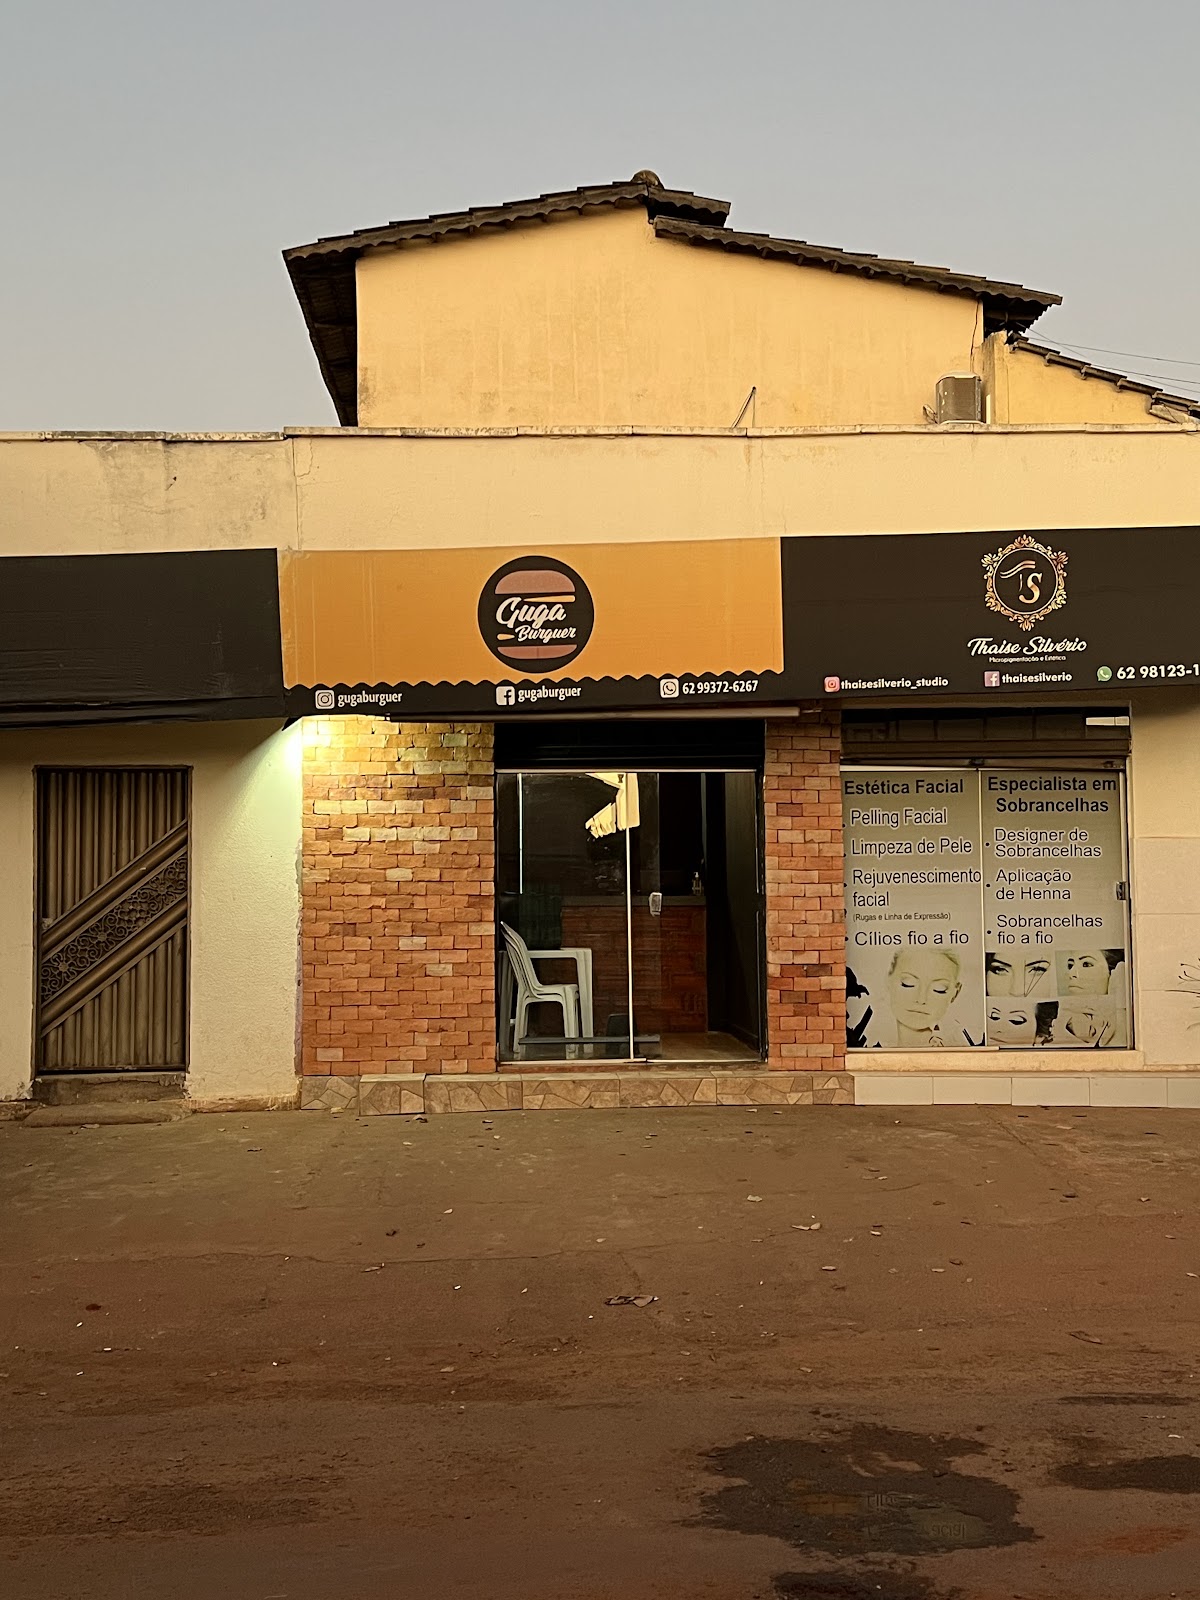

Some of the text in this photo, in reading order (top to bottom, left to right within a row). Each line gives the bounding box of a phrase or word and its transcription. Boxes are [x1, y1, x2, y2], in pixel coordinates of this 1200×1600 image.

[496, 597, 567, 629] Guga
[515, 625, 577, 644] Burguer
[967, 635, 1088, 657] Thaise Silvério
[1002, 671, 1072, 684] thaisesilverio
[1117, 666, 1136, 680] 62
[682, 680, 758, 694] 62 99372-6267
[841, 677, 948, 691] thaisesilverio_studio
[338, 690, 403, 707] gugaburguer
[518, 685, 581, 702] gugaburguer
[844, 778, 963, 795] Estética Facial
[988, 776, 1117, 794] Especialista em
[996, 798, 1109, 812] Sobrancelhas
[851, 808, 947, 828] Pelling Facial
[995, 828, 1088, 845] Designer de
[852, 838, 972, 858] Limpeza de Pele
[995, 844, 1102, 857] Sobrancelhas
[853, 868, 981, 888] Rejuvenescimento
[996, 869, 1072, 886] Aplicação
[853, 891, 889, 907] facial
[996, 886, 1071, 900] de Henna
[853, 913, 876, 922] (Rugas
[904, 912, 912, 920] de
[914, 912, 951, 921] Expressão)
[997, 914, 1103, 928] Sobrancelhas
[855, 930, 969, 946] Cílios fio a fio
[997, 931, 1054, 944] fio a fio
